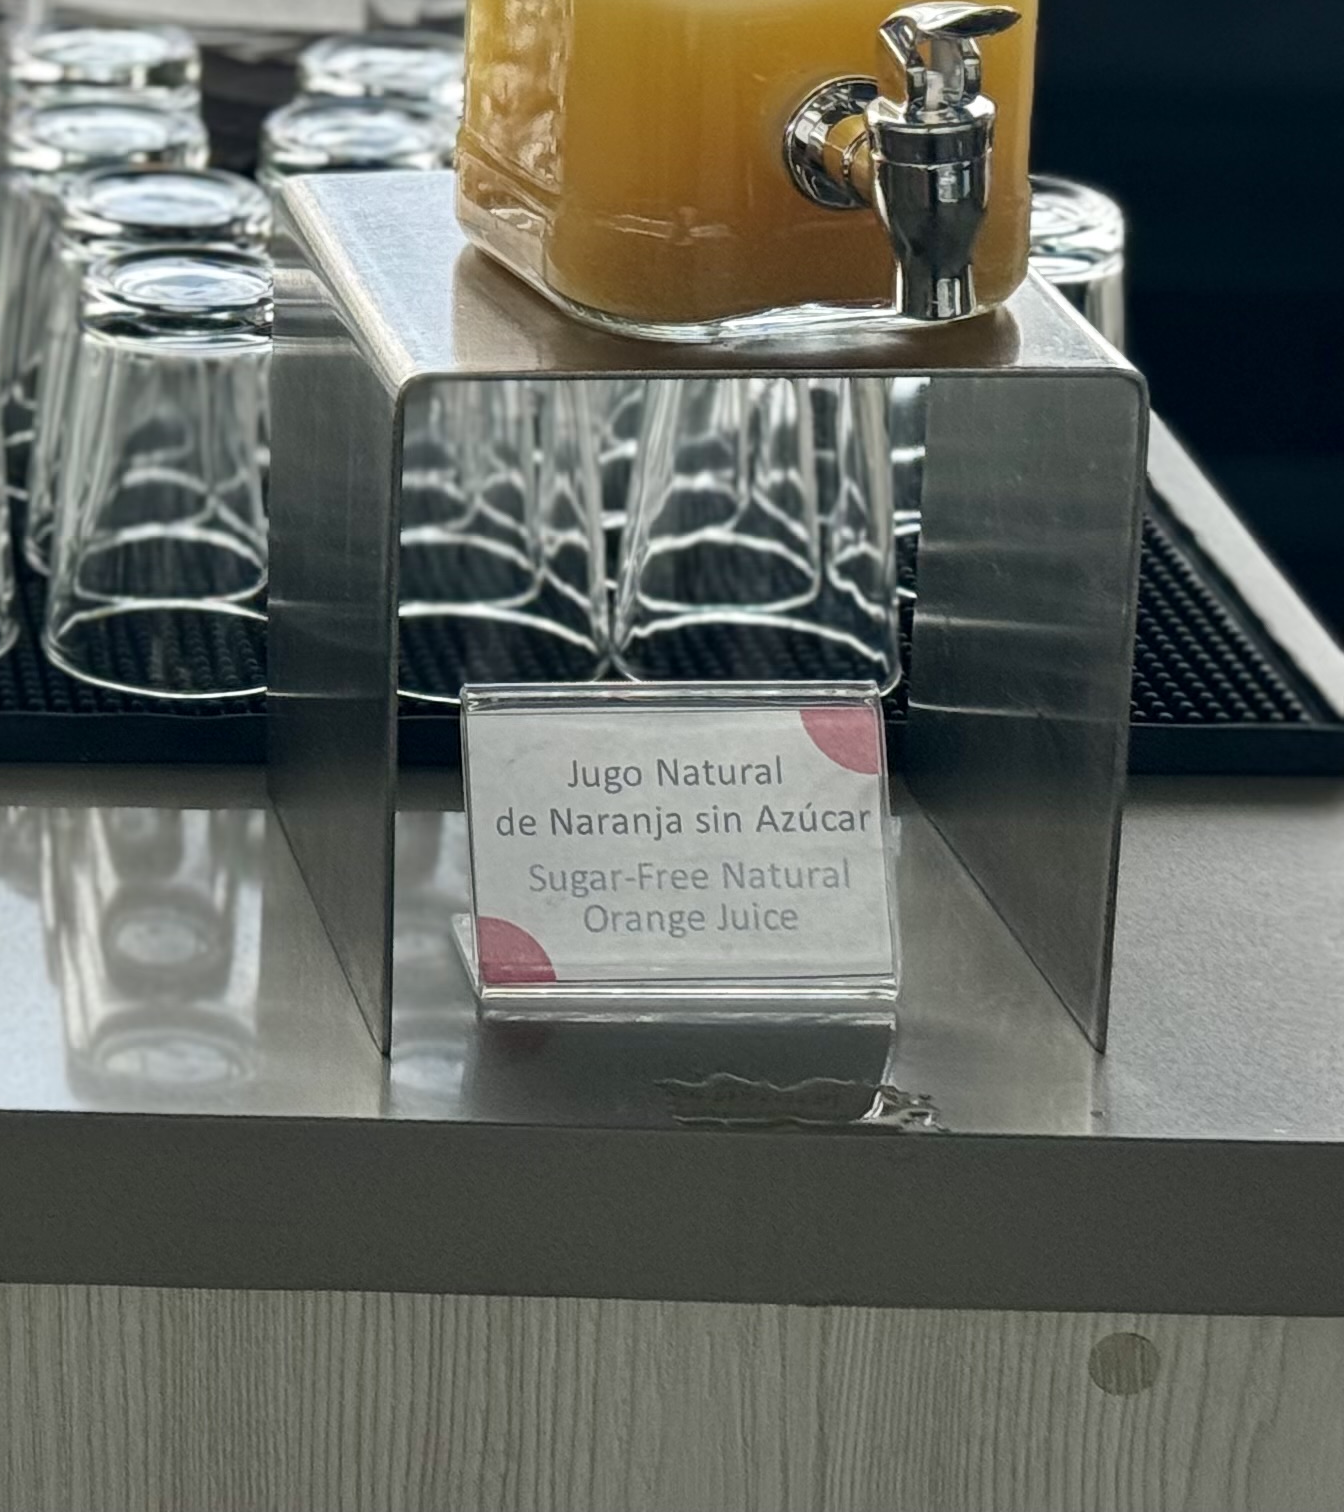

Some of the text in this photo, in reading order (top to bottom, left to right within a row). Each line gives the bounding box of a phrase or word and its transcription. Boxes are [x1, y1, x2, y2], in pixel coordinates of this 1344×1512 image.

[567, 755, 784, 794] Jugo Natural
[496, 801, 872, 841] de Naranja sin Azúcar
[528, 858, 851, 898] Sugar-Free Natural
[583, 902, 799, 938] Orange Juice
